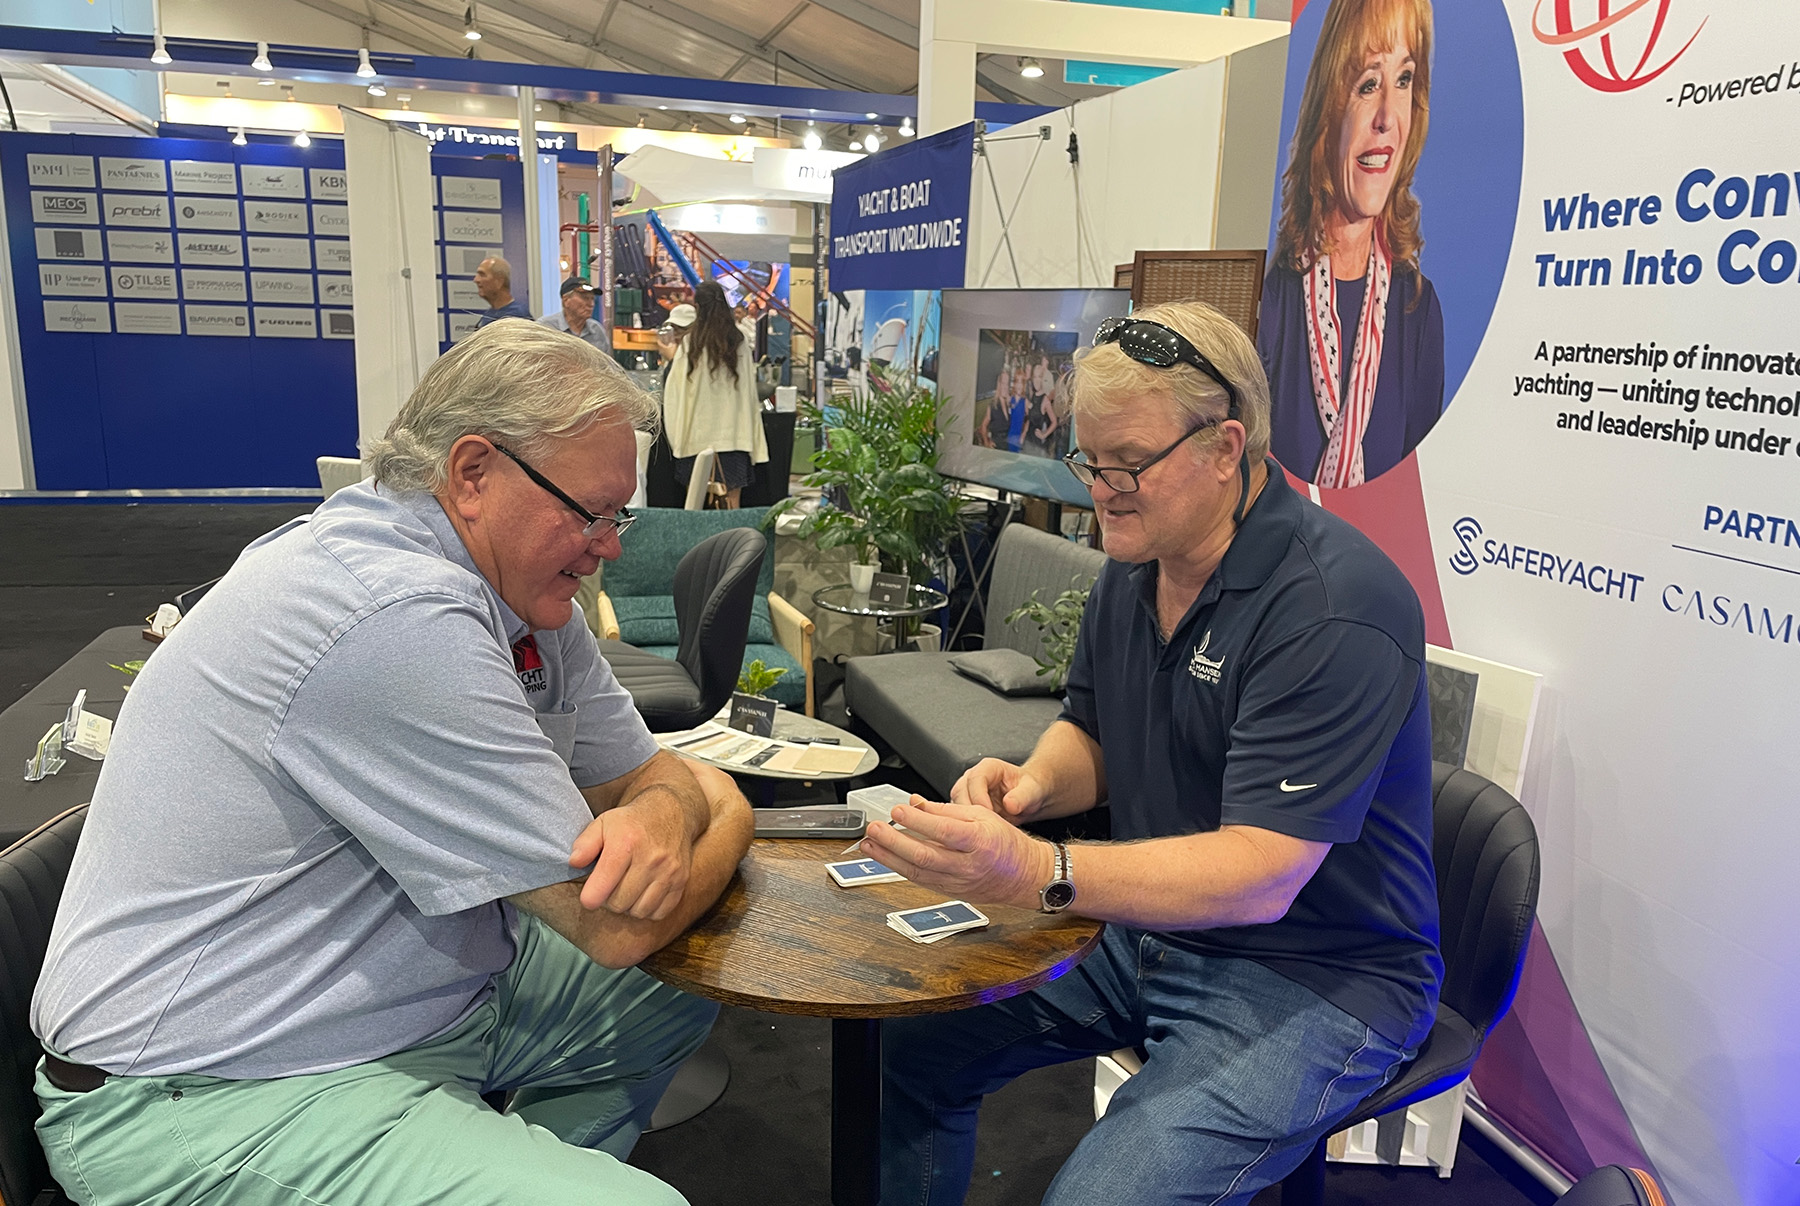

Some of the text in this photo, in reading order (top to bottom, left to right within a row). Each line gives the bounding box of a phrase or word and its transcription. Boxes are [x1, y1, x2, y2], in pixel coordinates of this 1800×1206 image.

[1678, 64, 1785, 107] Powered
[1787, 62, 1800, 93] b
[44, 198, 85, 213] MEOS
[112, 204, 162, 217] prebit
[858, 179, 932, 218] YACHT & BOAT
[1544, 169, 1800, 232] Where Con
[834, 217, 962, 259] TRANSPORT WORLDWIDE
[1535, 229, 1800, 287] Turn Into Co
[134, 274, 171, 286] TILSE
[1534, 341, 1548, 361] A
[1552, 342, 1668, 372] partnership
[1673, 345, 1699, 369] of
[1513, 373, 1593, 402] yachting
[1622, 378, 1700, 412] uniting
[1557, 410, 1791, 455] and leadership under
[1483, 540, 1644, 602] SAFERYACHT
[1663, 585, 1800, 643] CASAM
[517, 669, 543, 685] CHT
[525, 681, 547, 694] PING
